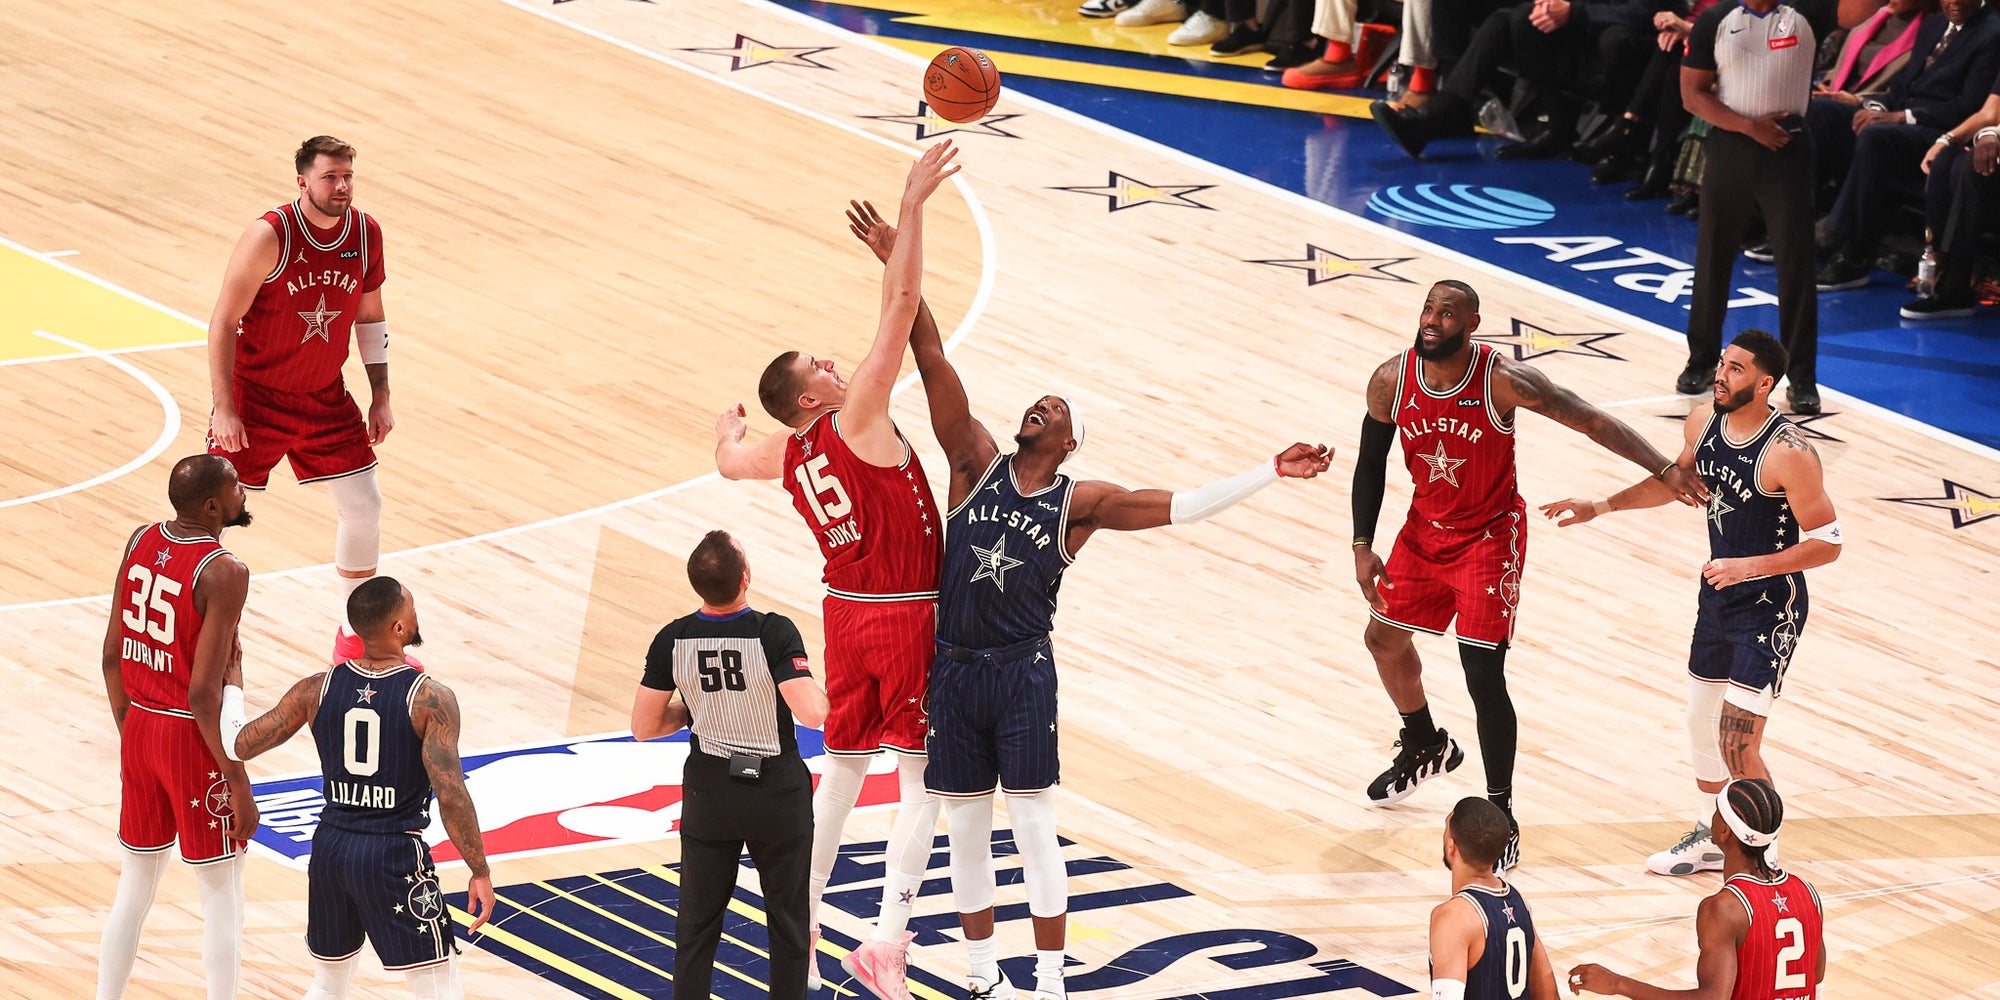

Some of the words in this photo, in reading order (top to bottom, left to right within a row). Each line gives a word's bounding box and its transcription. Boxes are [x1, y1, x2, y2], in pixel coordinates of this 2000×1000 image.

[286, 270, 358, 297] ALL-STAR
[1402, 417, 1483, 444] ALL-STAR
[794, 452, 853, 528] 15
[968, 504, 1051, 551] ALL-STAR
[122, 563, 183, 646] 35
[121, 636, 175, 675] DURANT
[696, 649, 747, 693] 58
[343, 707, 381, 777] 0
[330, 780, 396, 809] LILLARD
[1505, 926, 1527, 1000] 0
[1774, 917, 1807, 990] 2
